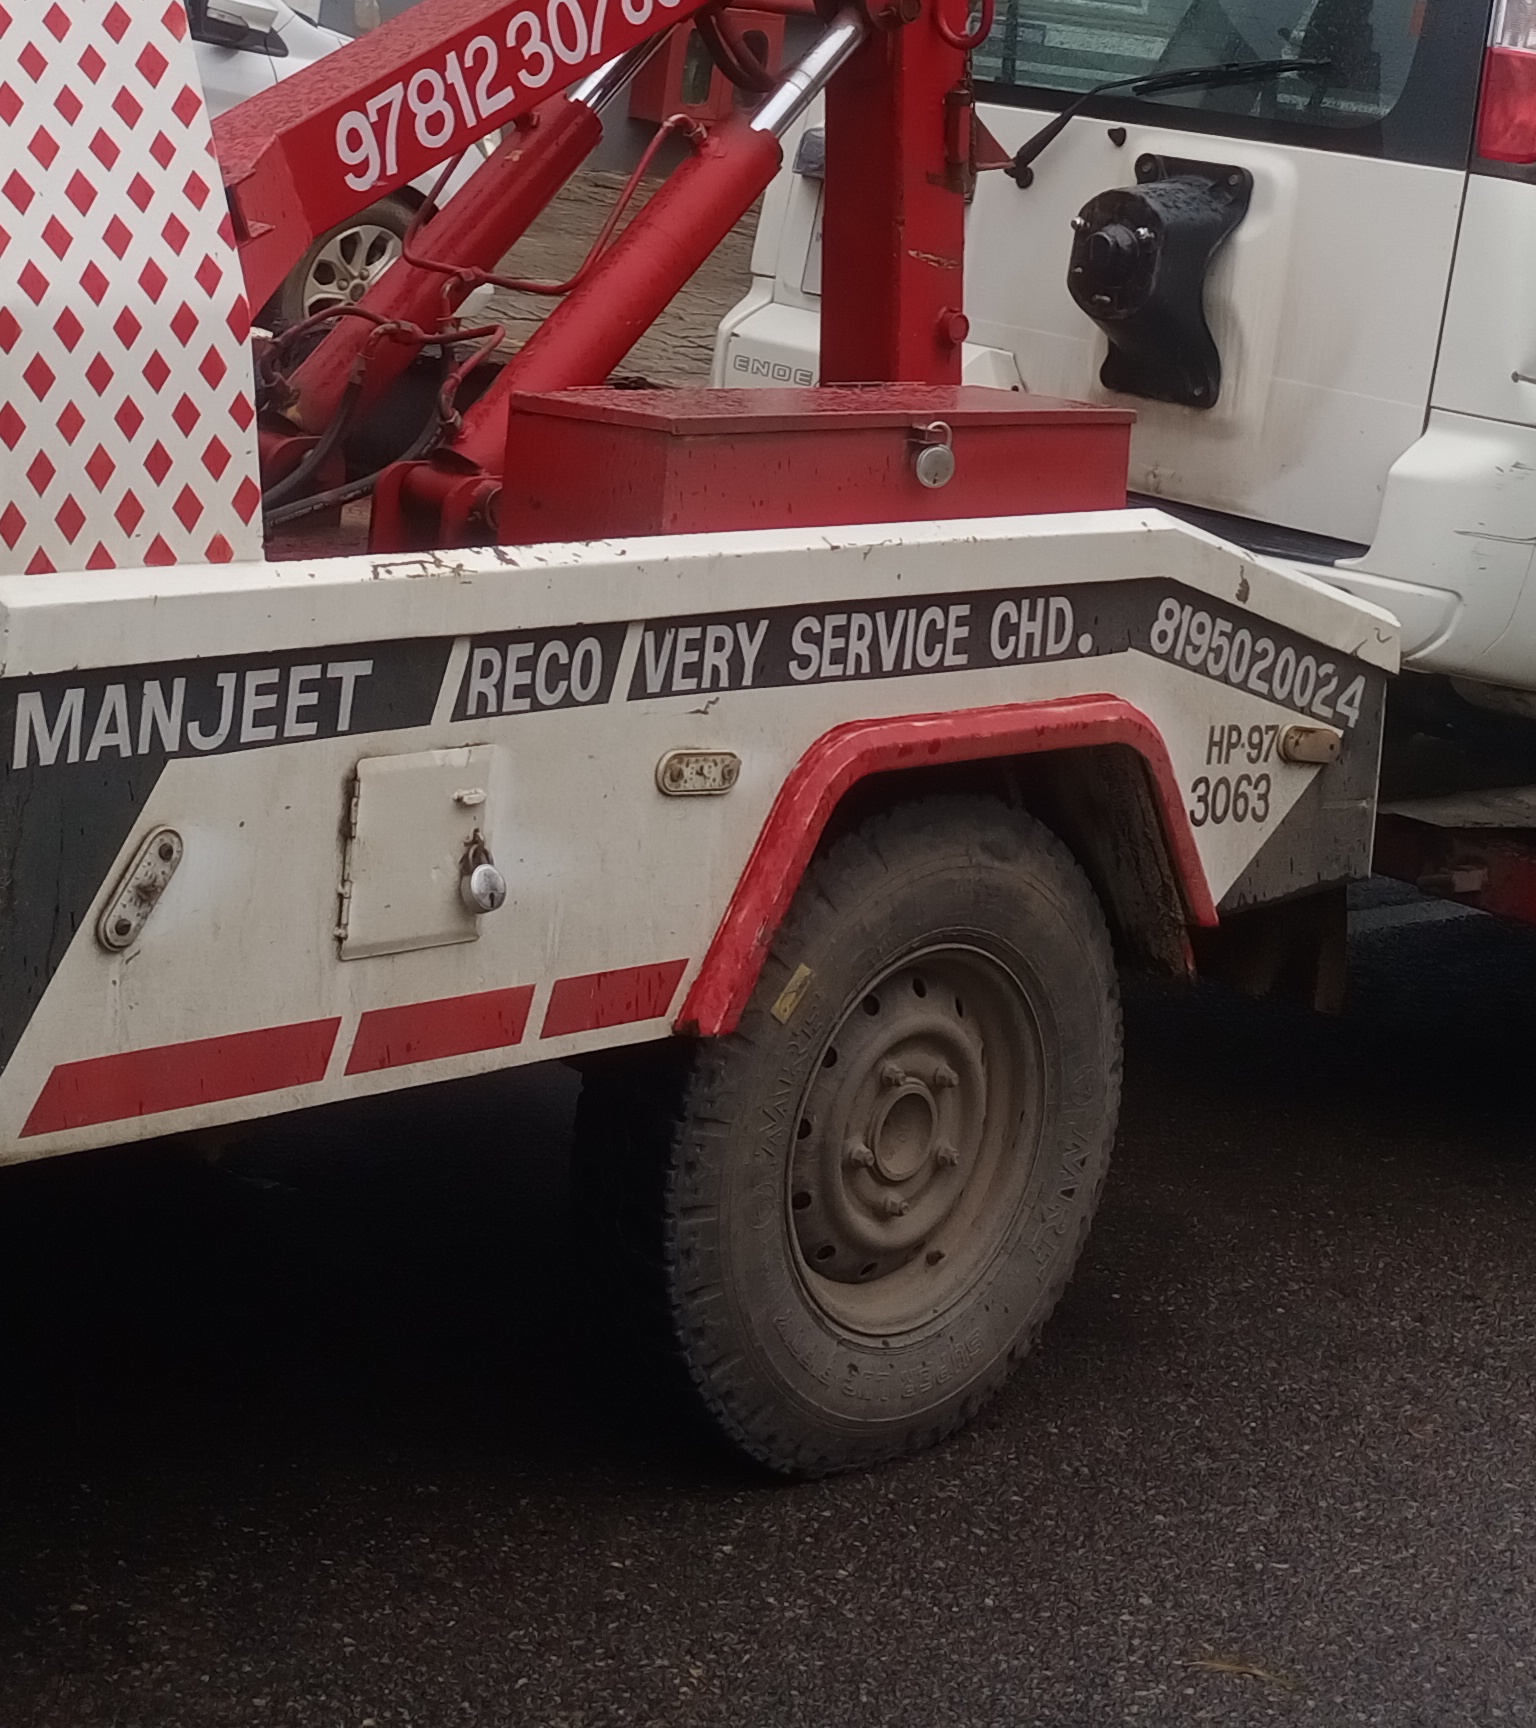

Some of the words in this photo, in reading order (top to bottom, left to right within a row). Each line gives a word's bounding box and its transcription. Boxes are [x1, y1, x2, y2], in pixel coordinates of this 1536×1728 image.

[733, 354, 820, 388] ENDE
[12, 659, 374, 770] MANJEET
[788, 604, 971, 681] SERVICE
[990, 595, 1094, 660] CHD.
[1150, 597, 1366, 729] 8195020024
[1189, 773, 1271, 828] 3063
